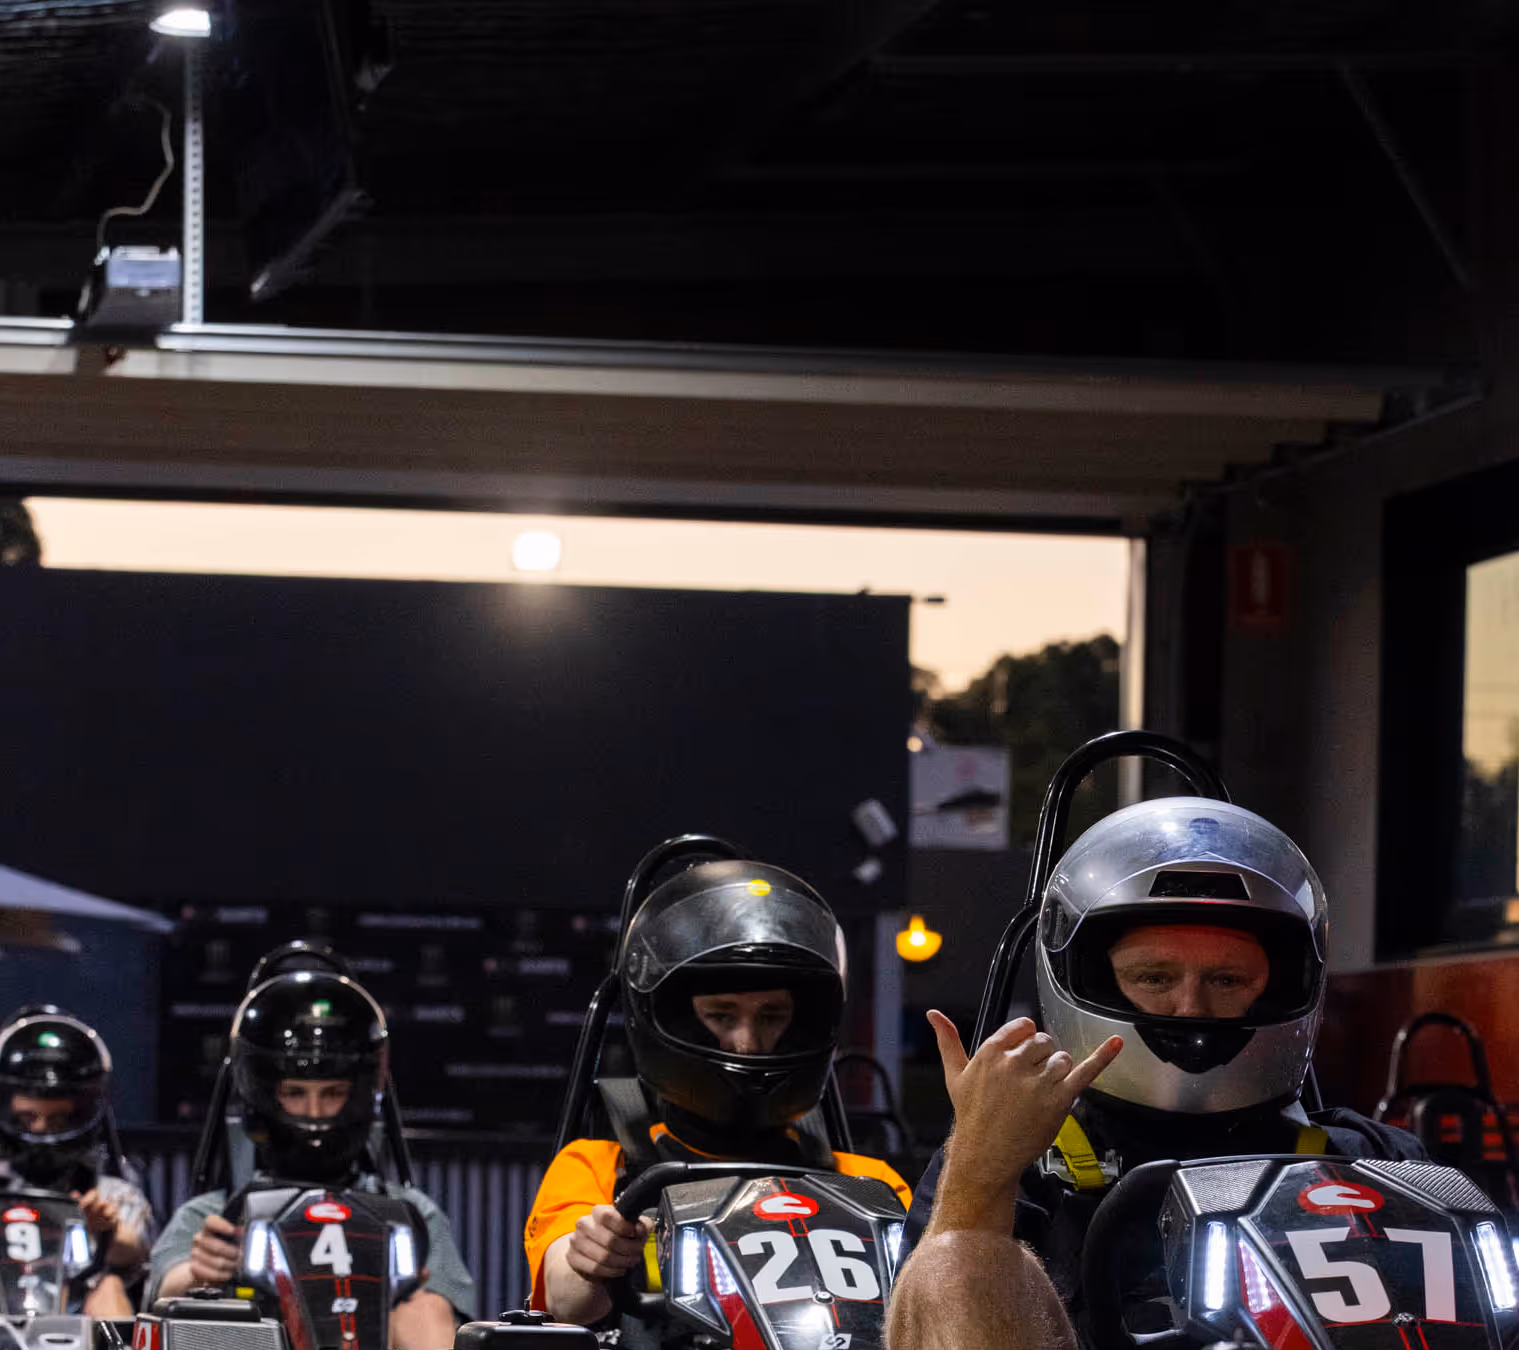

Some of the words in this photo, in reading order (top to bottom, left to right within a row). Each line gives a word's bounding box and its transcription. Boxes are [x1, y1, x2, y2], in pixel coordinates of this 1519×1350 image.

[4, 1222, 42, 1262] 9
[309, 1222, 353, 1277] 4
[737, 1228, 881, 1304] 26
[1285, 1226, 1457, 1323] 57
